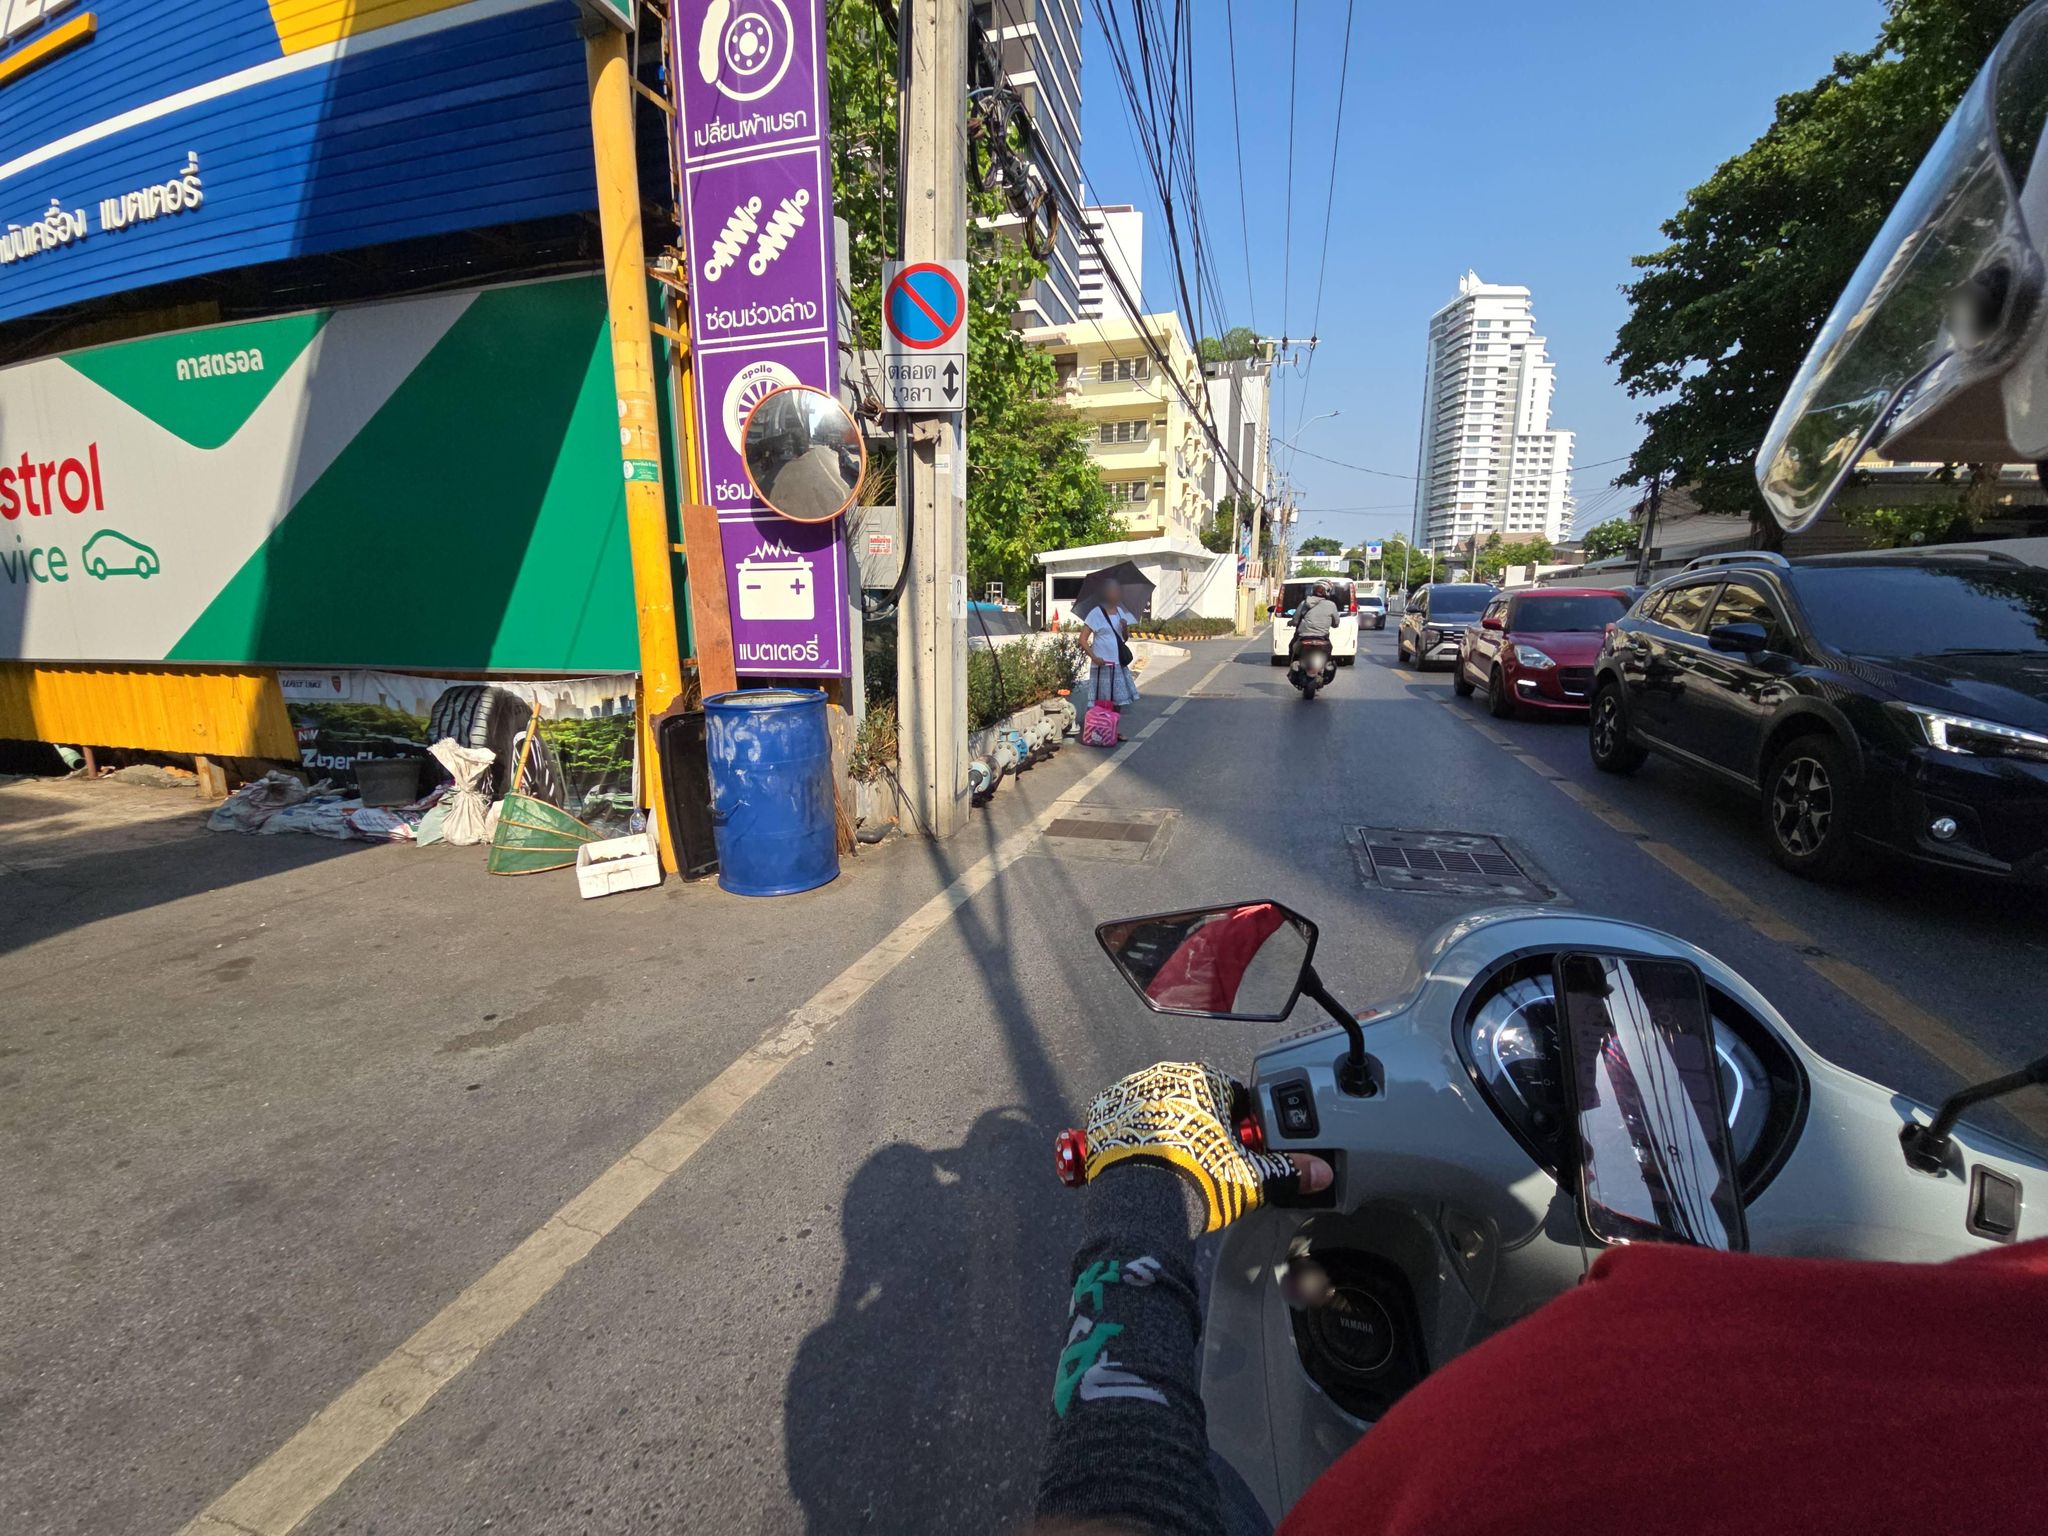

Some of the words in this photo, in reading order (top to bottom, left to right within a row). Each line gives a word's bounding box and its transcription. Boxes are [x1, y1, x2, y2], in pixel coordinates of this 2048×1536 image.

[694, 110, 807, 147] เปลี่ยนผ้าเบรก
[99, 150, 204, 231] แบตเตอรี่
[705, 297, 817, 330] ซ่อมช่วงล่าง
[176, 348, 264, 381] คาสตรอล
[741, 364, 773, 380] apollo
[888, 364, 936, 380] ตลอด
[893, 386, 932, 402] เวลา
[739, 633, 819, 662] แบตเตอรี่
[1340, 1316, 1374, 1335] YAMAHA
